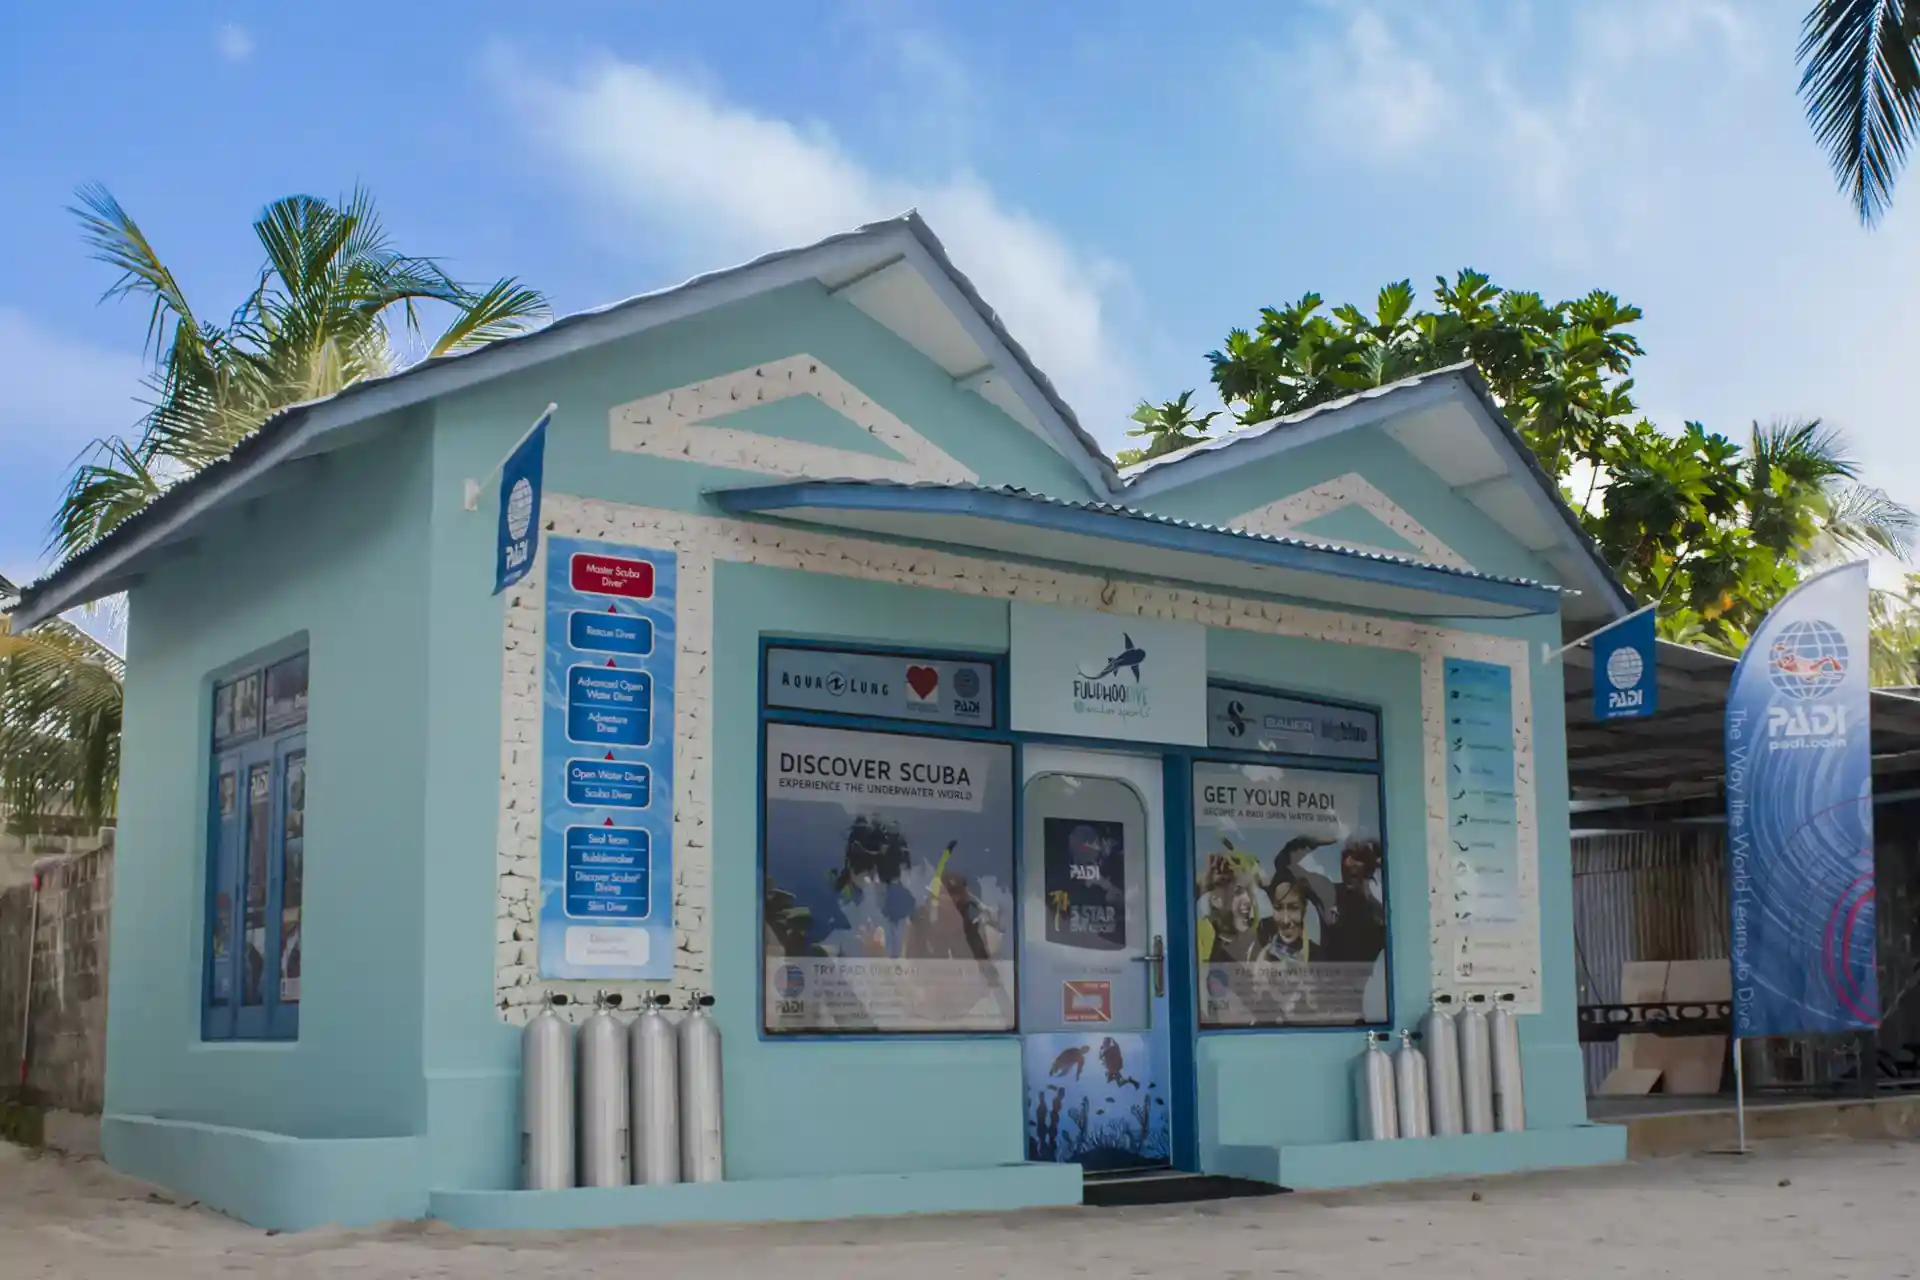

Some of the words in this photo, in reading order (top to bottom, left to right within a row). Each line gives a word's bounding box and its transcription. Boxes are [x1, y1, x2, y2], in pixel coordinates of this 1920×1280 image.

[586, 563, 614, 576] Master
[615, 566, 640, 579] Scuba
[619, 680, 644, 693] Open
[782, 669, 822, 690] AQUA
[851, 680, 889, 697] LUNG
[1608, 689, 1644, 708] PADI
[1730, 706, 1748, 740] The
[1768, 704, 1848, 738] PADI
[1768, 737, 1847, 752] padi.com
[572, 767, 597, 780] Open
[597, 769, 623, 781] Water
[780, 752, 891, 780] DISCOVER
[899, 762, 971, 787] SCUBA
[1727, 745, 1748, 794] Way
[779, 777, 841, 792] EXPERIENCE
[845, 782, 864, 793] THE
[866, 785, 934, 799] UNDERWATER
[938, 791, 973, 801] WORLD
[1204, 785, 1237, 804] GET
[1243, 787, 1291, 808] YOUR
[1297, 792, 1335, 810] PADI
[1732, 832, 1752, 891] World
[574, 871, 610, 882] Discover
[1070, 864, 1101, 881] PADI
[594, 882, 622, 895] Diving
[813, 964, 836, 976] TRY
[1736, 986, 1754, 1029] Dive
